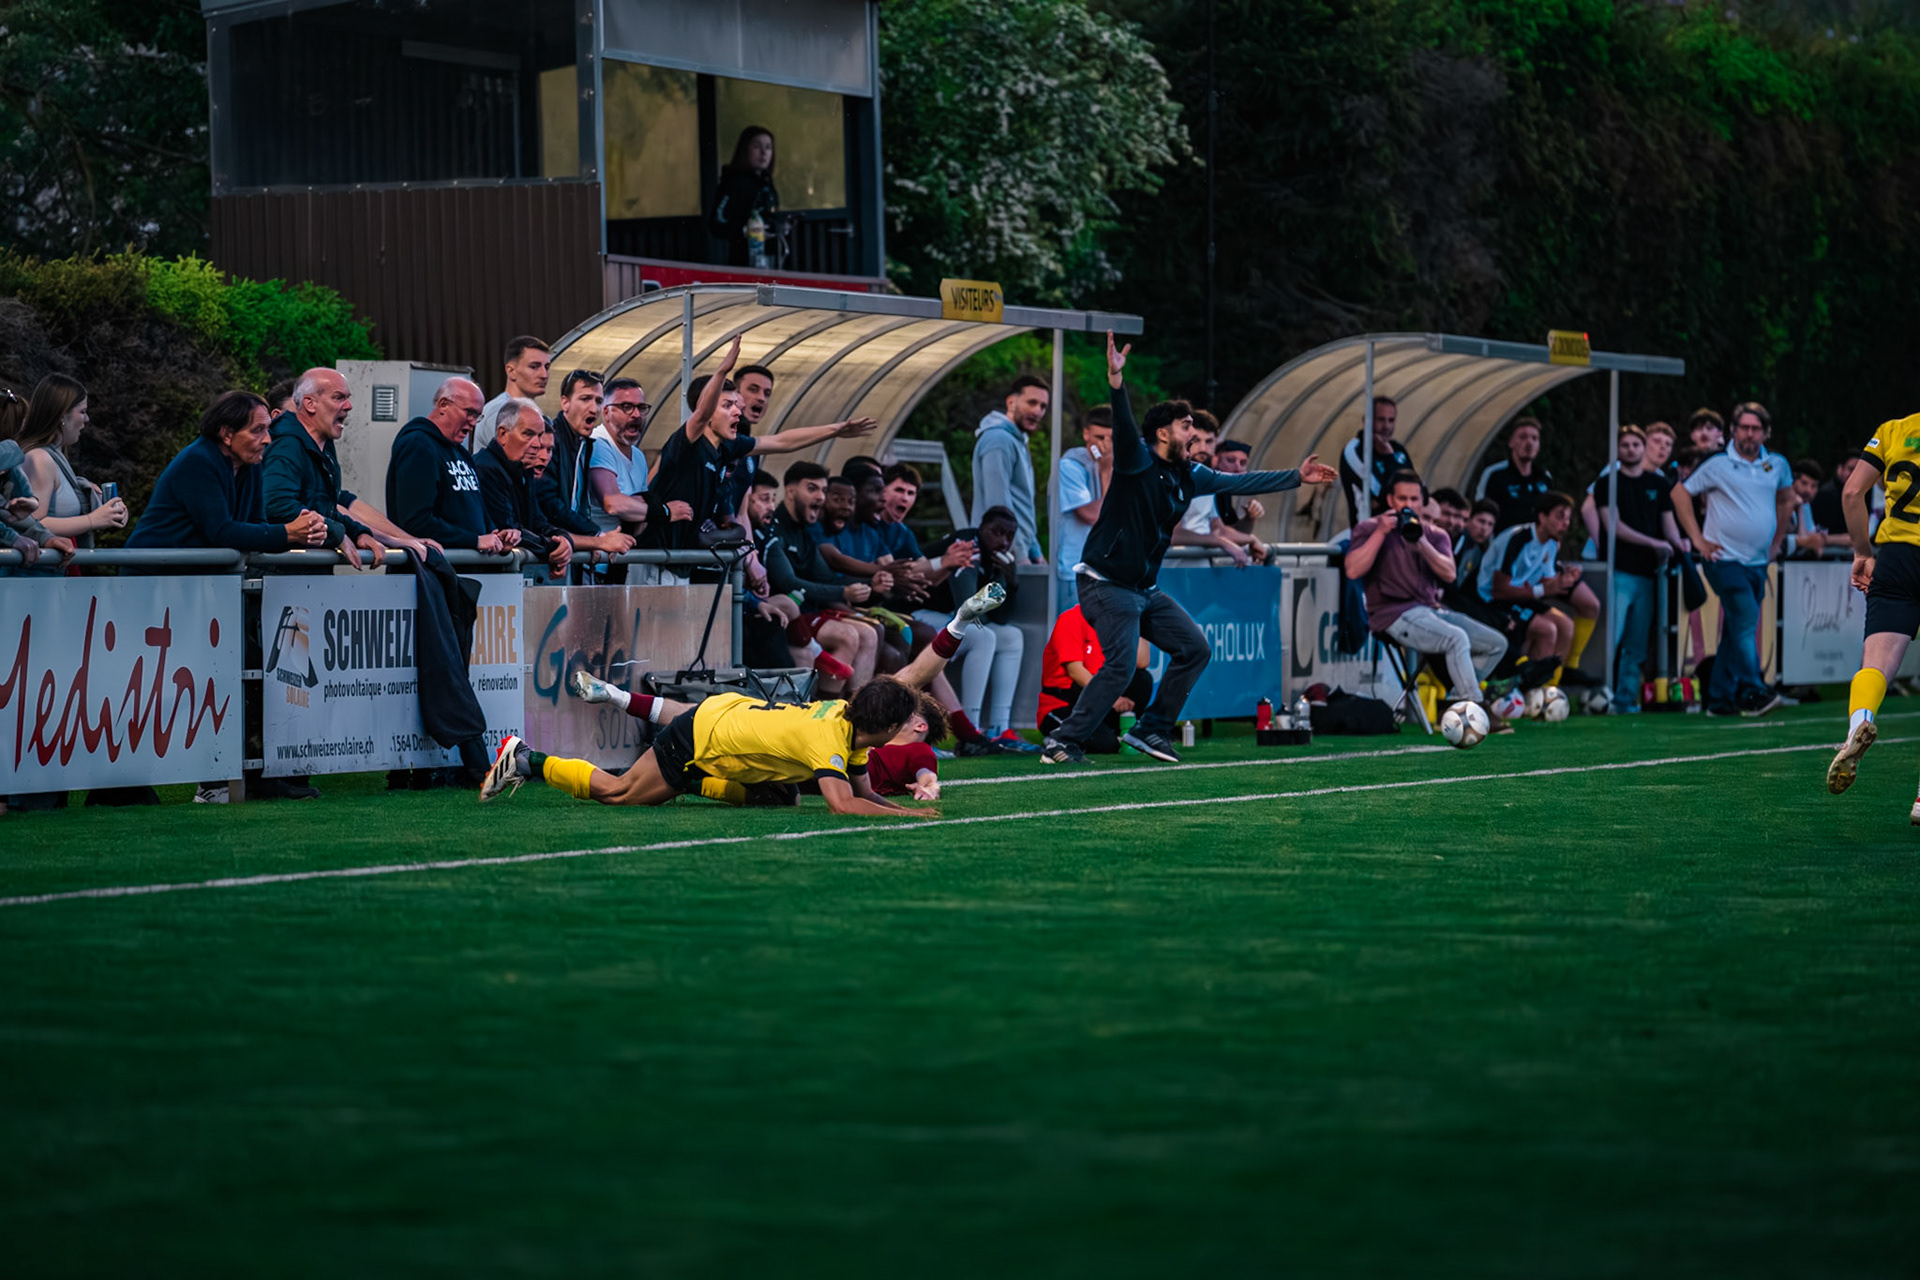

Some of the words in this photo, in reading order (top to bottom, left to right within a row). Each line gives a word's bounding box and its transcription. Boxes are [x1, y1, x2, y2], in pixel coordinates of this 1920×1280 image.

[951, 287, 995, 312] VISITEURS
[324, 608, 418, 672] SCHWEIZ
[470, 604, 517, 665] AIRE
[1197, 622, 1265, 662] CHOLUX
[324, 678, 381, 703] photovoltaïque
[387, 678, 418, 695] couvert
[477, 673, 518, 691] rénovation
[277, 736, 374, 759] www.schweizersolaire.ch
[392, 734, 411, 752] 1564
